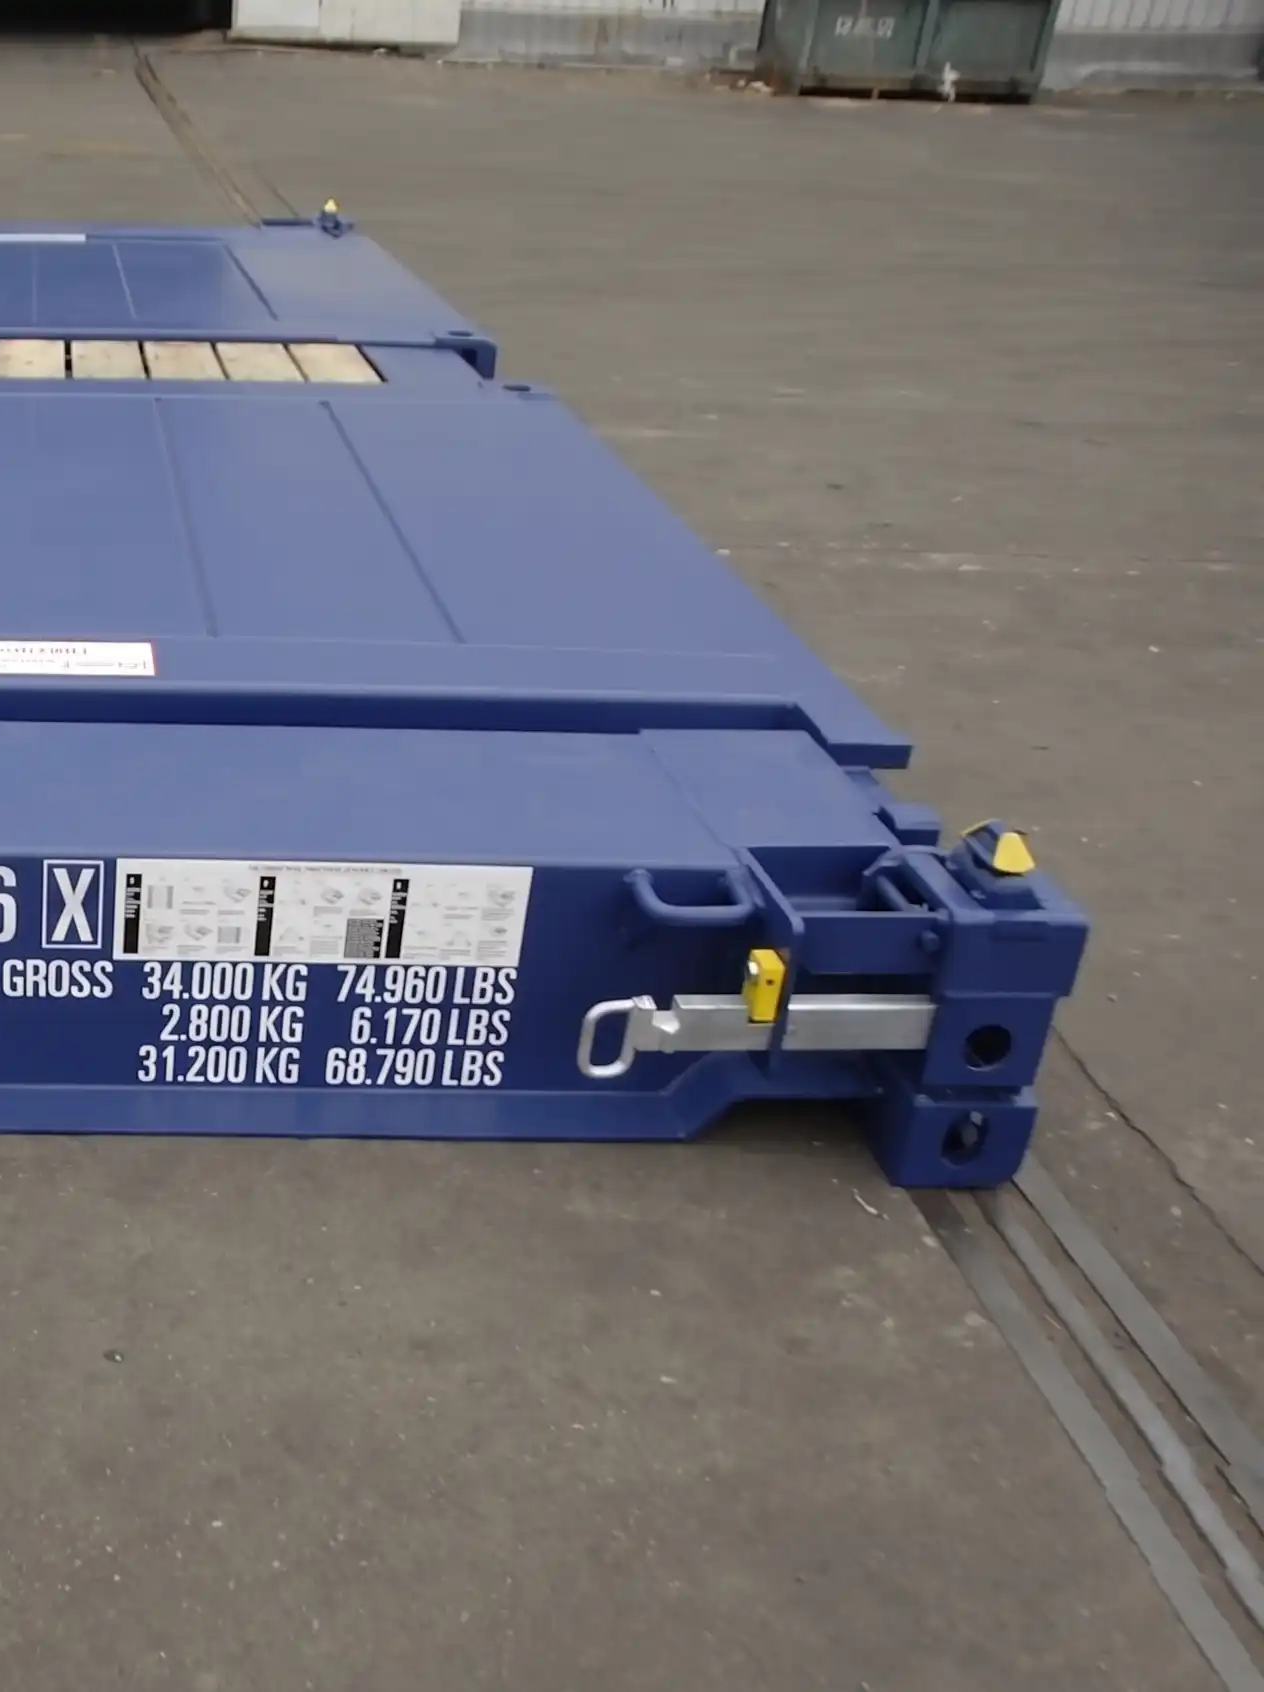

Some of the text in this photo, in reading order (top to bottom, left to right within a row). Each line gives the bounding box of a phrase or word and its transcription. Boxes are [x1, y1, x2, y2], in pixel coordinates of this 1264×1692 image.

[50, 867, 96, 943] X
[2, 958, 114, 999] GROSS
[141, 961, 255, 1000] 34.000
[261, 962, 308, 1001] KG
[336, 964, 447, 1004] 74.960
[452, 966, 517, 1004] LBS
[159, 1003, 252, 1043] 2.800
[258, 1005, 305, 1043] KG
[350, 1006, 442, 1046] 6.170
[446, 1008, 511, 1046] LBS
[137, 1044, 248, 1084] 31.200
[254, 1046, 301, 1084] KG
[325, 1047, 436, 1086] 68.790
[441, 1049, 505, 1087] LBS
